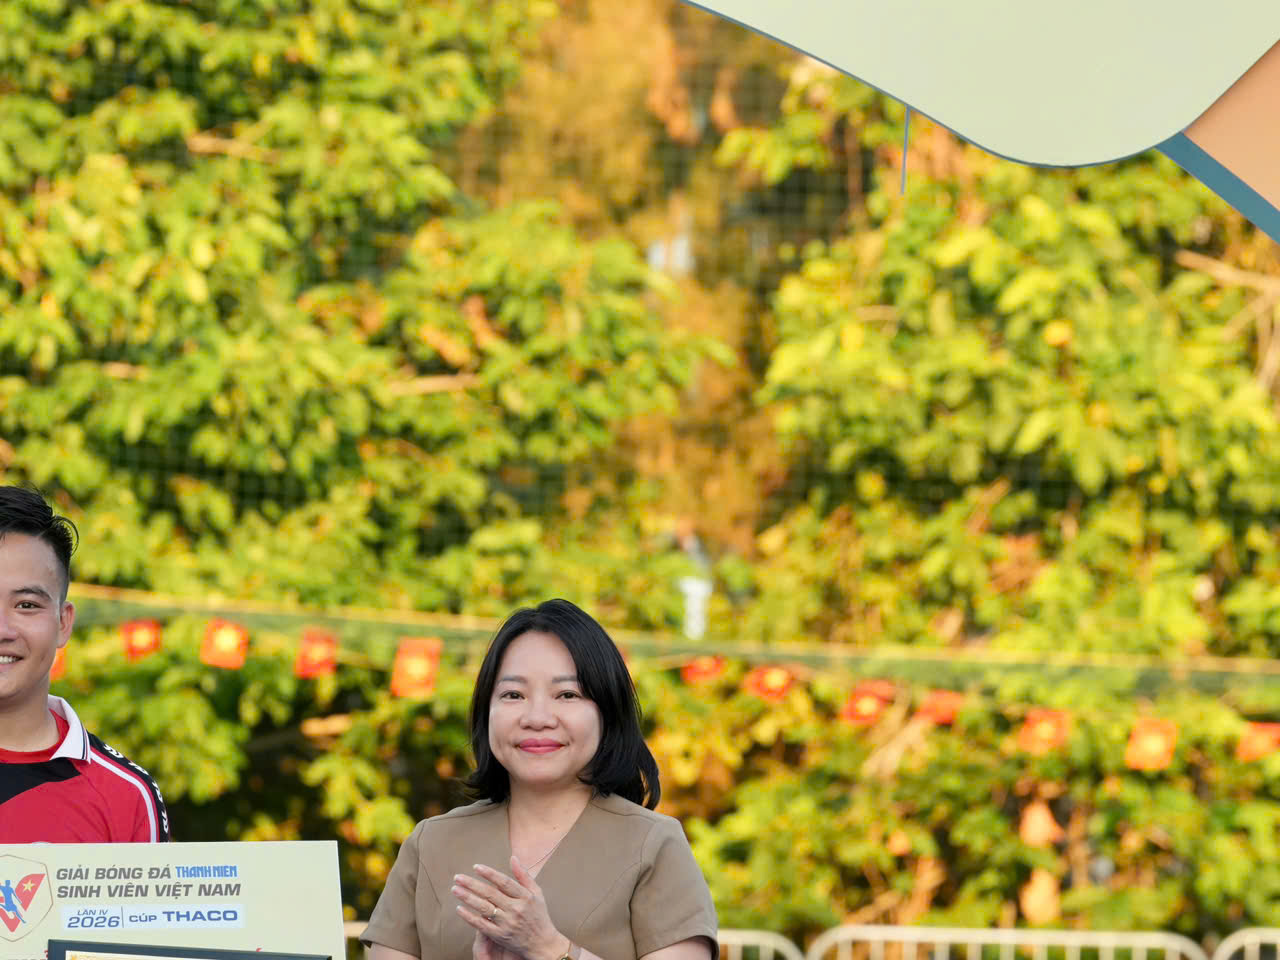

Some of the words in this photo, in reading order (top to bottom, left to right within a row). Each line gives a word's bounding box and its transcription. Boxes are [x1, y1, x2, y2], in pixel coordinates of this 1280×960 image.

[56, 865, 89, 880] GIẢI
[94, 864, 143, 880] BÓNG
[148, 863, 171, 879] ĐÁ
[57, 885, 100, 899] SINH
[107, 882, 149, 898] VIÊN
[155, 881, 193, 900] VIỆT
[197, 883, 241, 897] NAM
[99, 908, 109, 916] IV
[129, 912, 158, 923] CÚP
[162, 910, 238, 922] THACO
[67, 916, 121, 928] 2026
